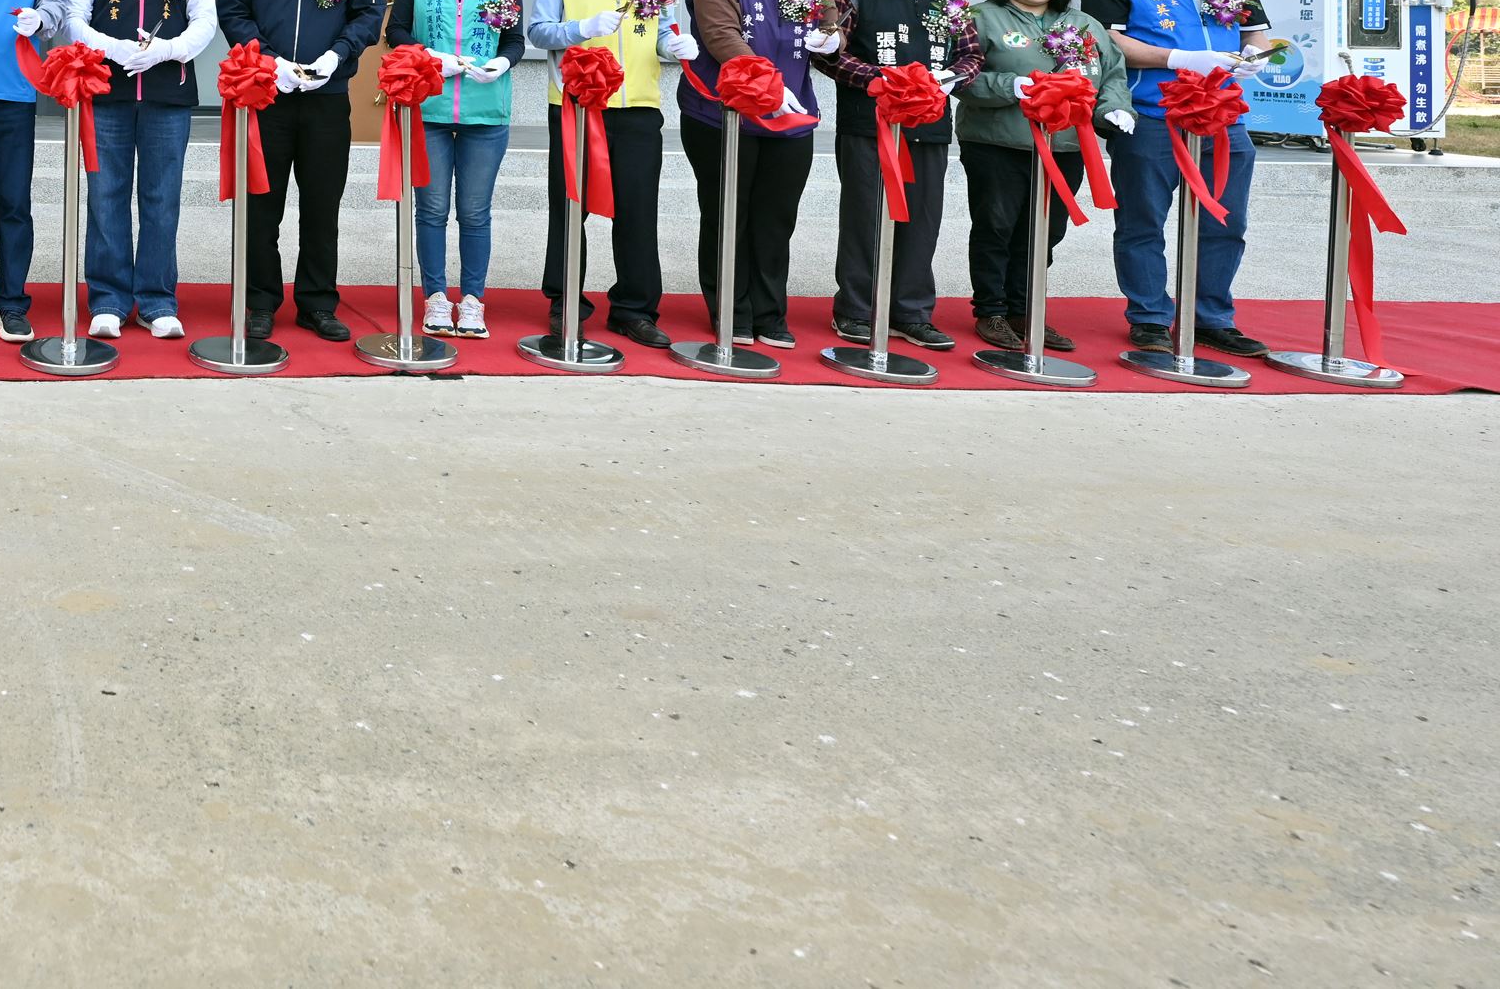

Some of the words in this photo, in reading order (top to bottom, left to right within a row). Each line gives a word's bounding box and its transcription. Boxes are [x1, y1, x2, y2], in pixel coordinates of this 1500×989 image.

[898, 23, 910, 44] 助理
[876, 31, 897, 69] 張建
[1273, 75, 1291, 84] XIAO
[1415, 25, 1428, 123] 需煮沸，勿生飲
